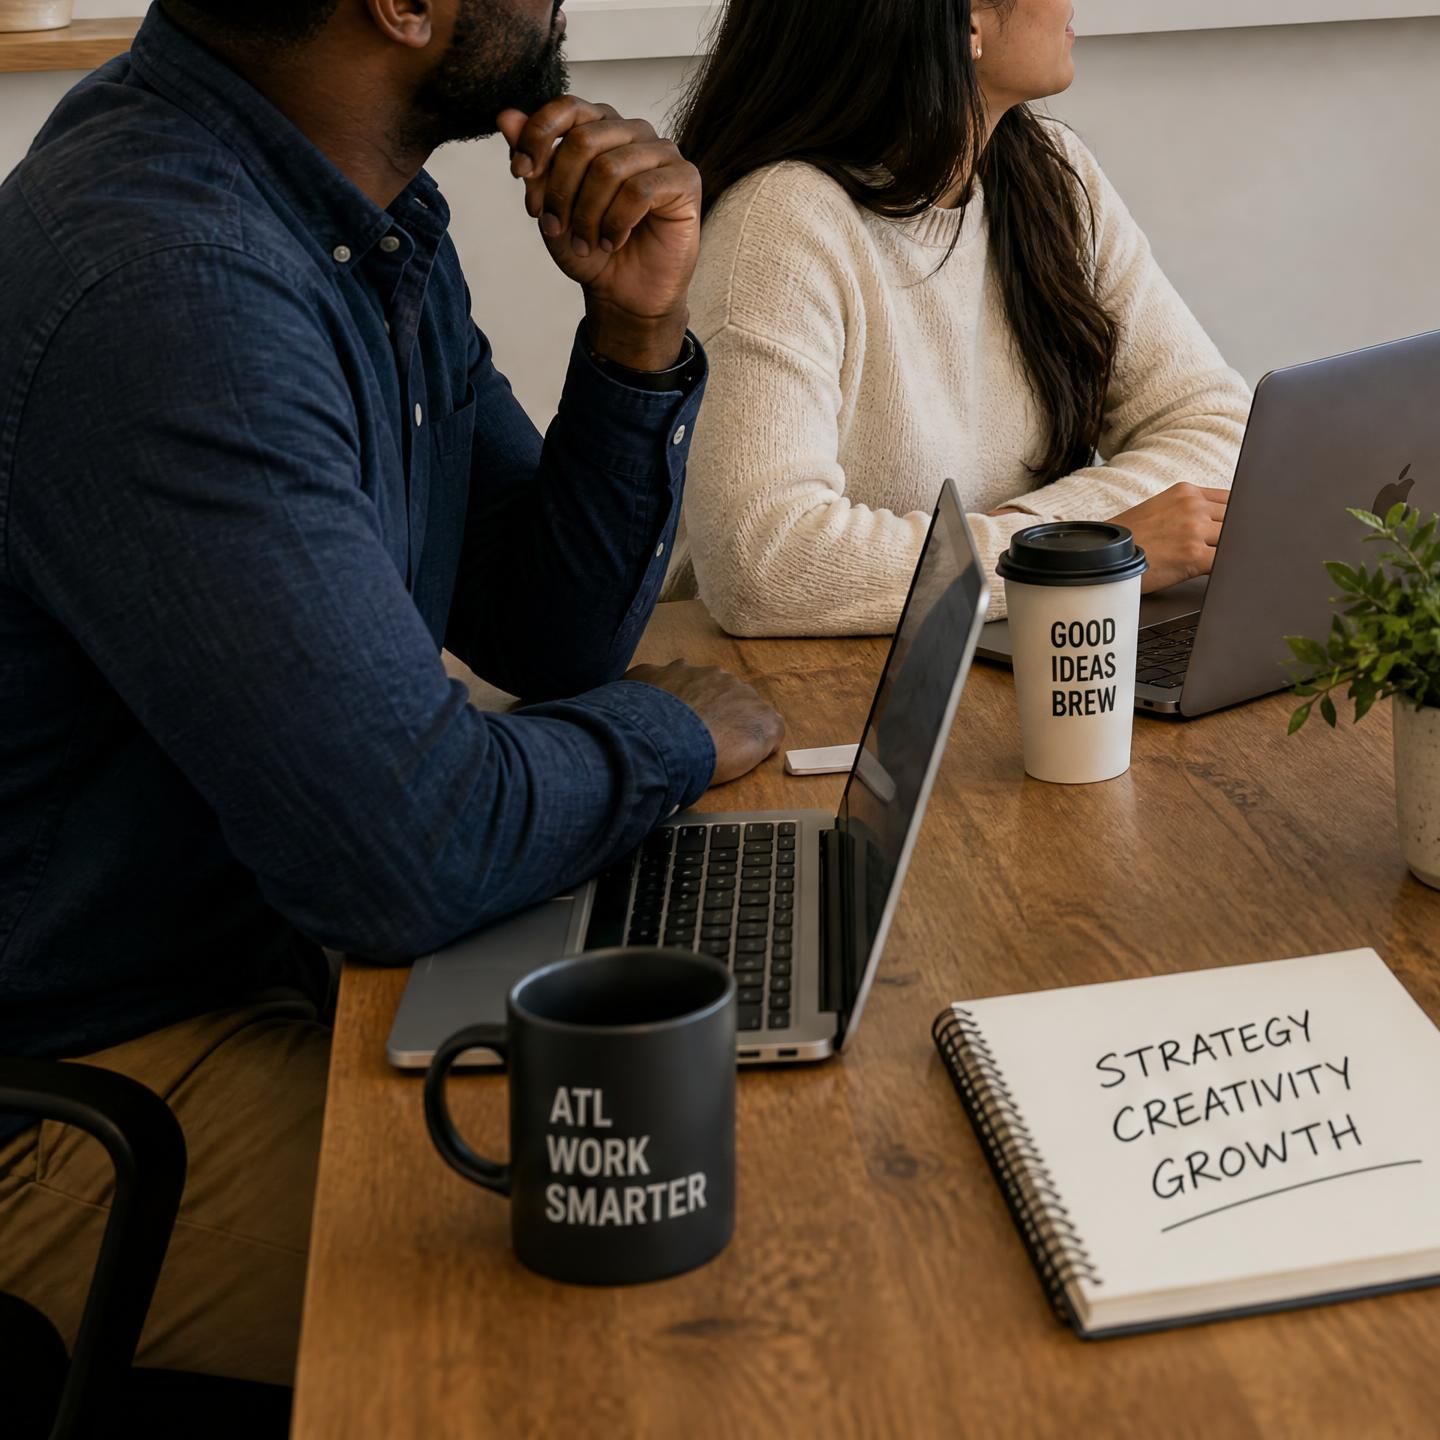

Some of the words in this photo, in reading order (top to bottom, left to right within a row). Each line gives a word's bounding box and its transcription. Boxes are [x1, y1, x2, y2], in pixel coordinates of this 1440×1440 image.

[1051, 618, 1115, 648] GOOD
[1052, 652, 1115, 682] IDEAS
[1052, 686, 1116, 717] BREW
[1095, 1009, 1314, 1089] STRATEGY
[551, 1088, 612, 1126] ATL
[1111, 1056, 1352, 1144] CREATIVITY
[548, 1136, 649, 1176] WORK
[1151, 1114, 1362, 1200] GROWTH
[547, 1172, 706, 1225] SMARTER
